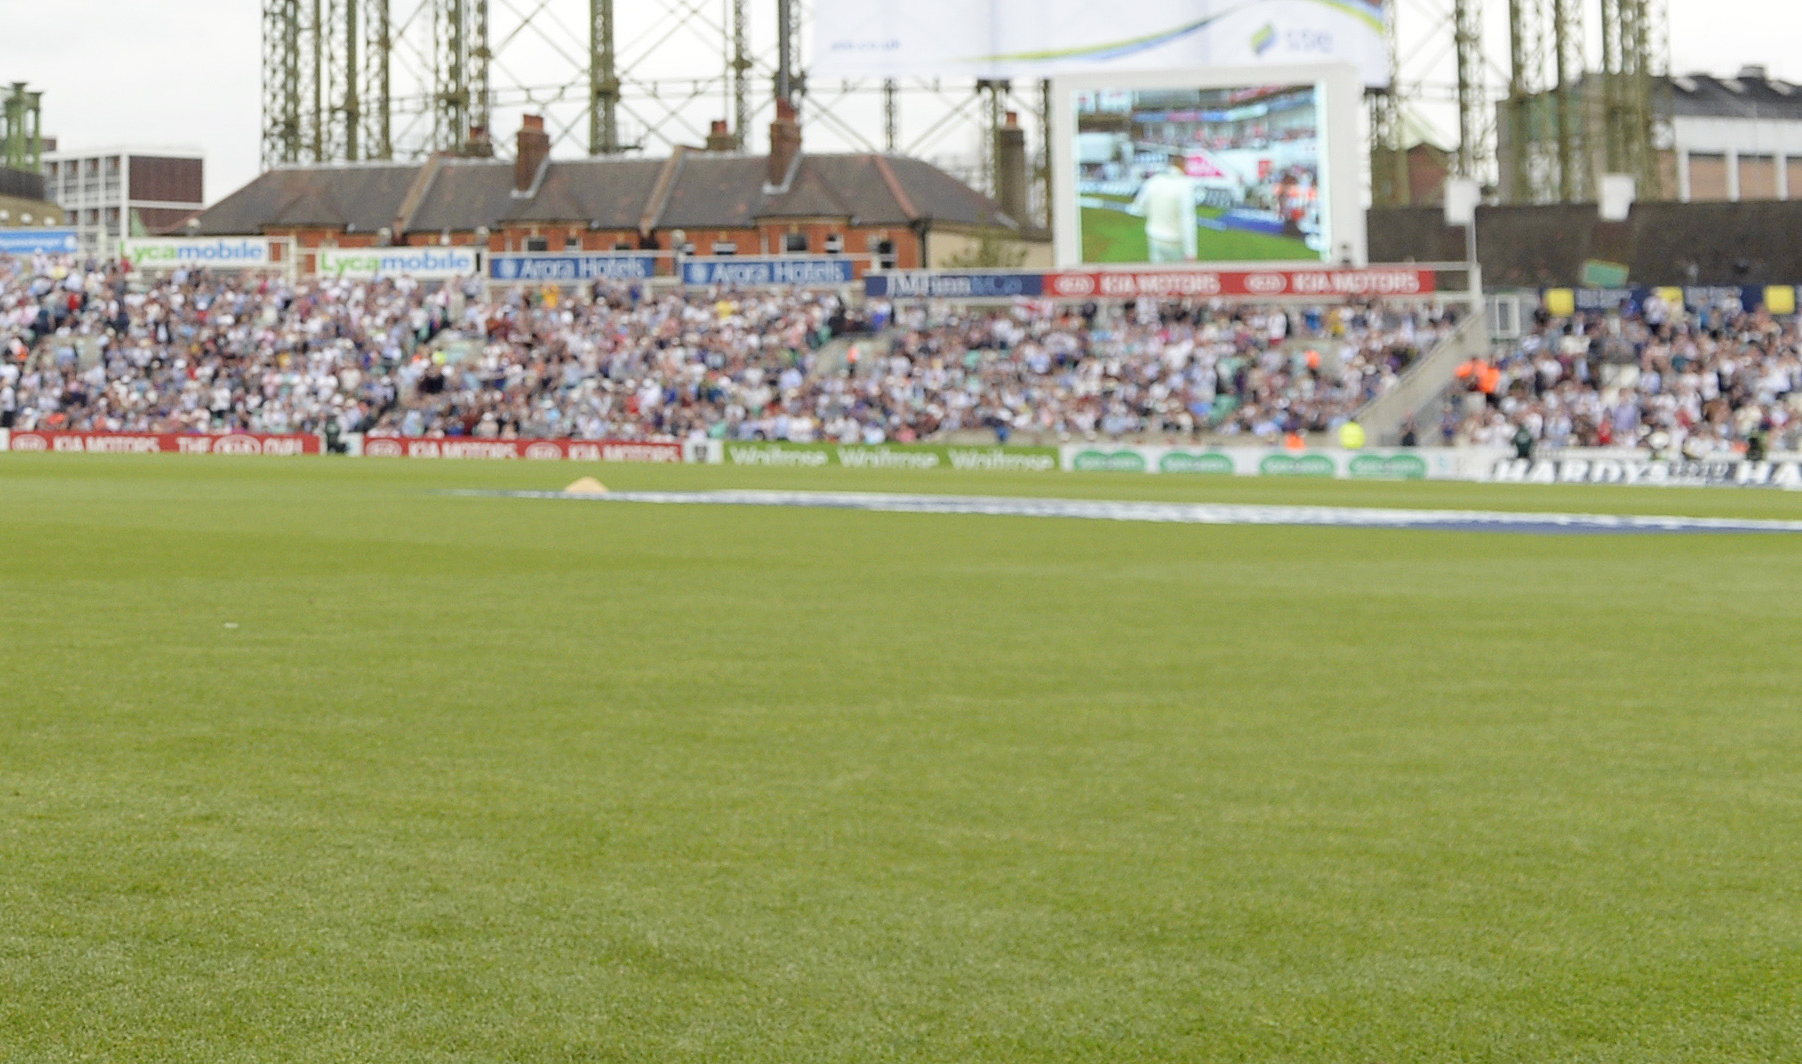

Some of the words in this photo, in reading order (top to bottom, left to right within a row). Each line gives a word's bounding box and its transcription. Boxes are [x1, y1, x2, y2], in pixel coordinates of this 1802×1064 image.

[321, 252, 470, 274] Lycamobile
[1100, 273, 1135, 294] KIA
[1292, 272, 1331, 293] KIA
[1331, 272, 1420, 294] MOTORS
